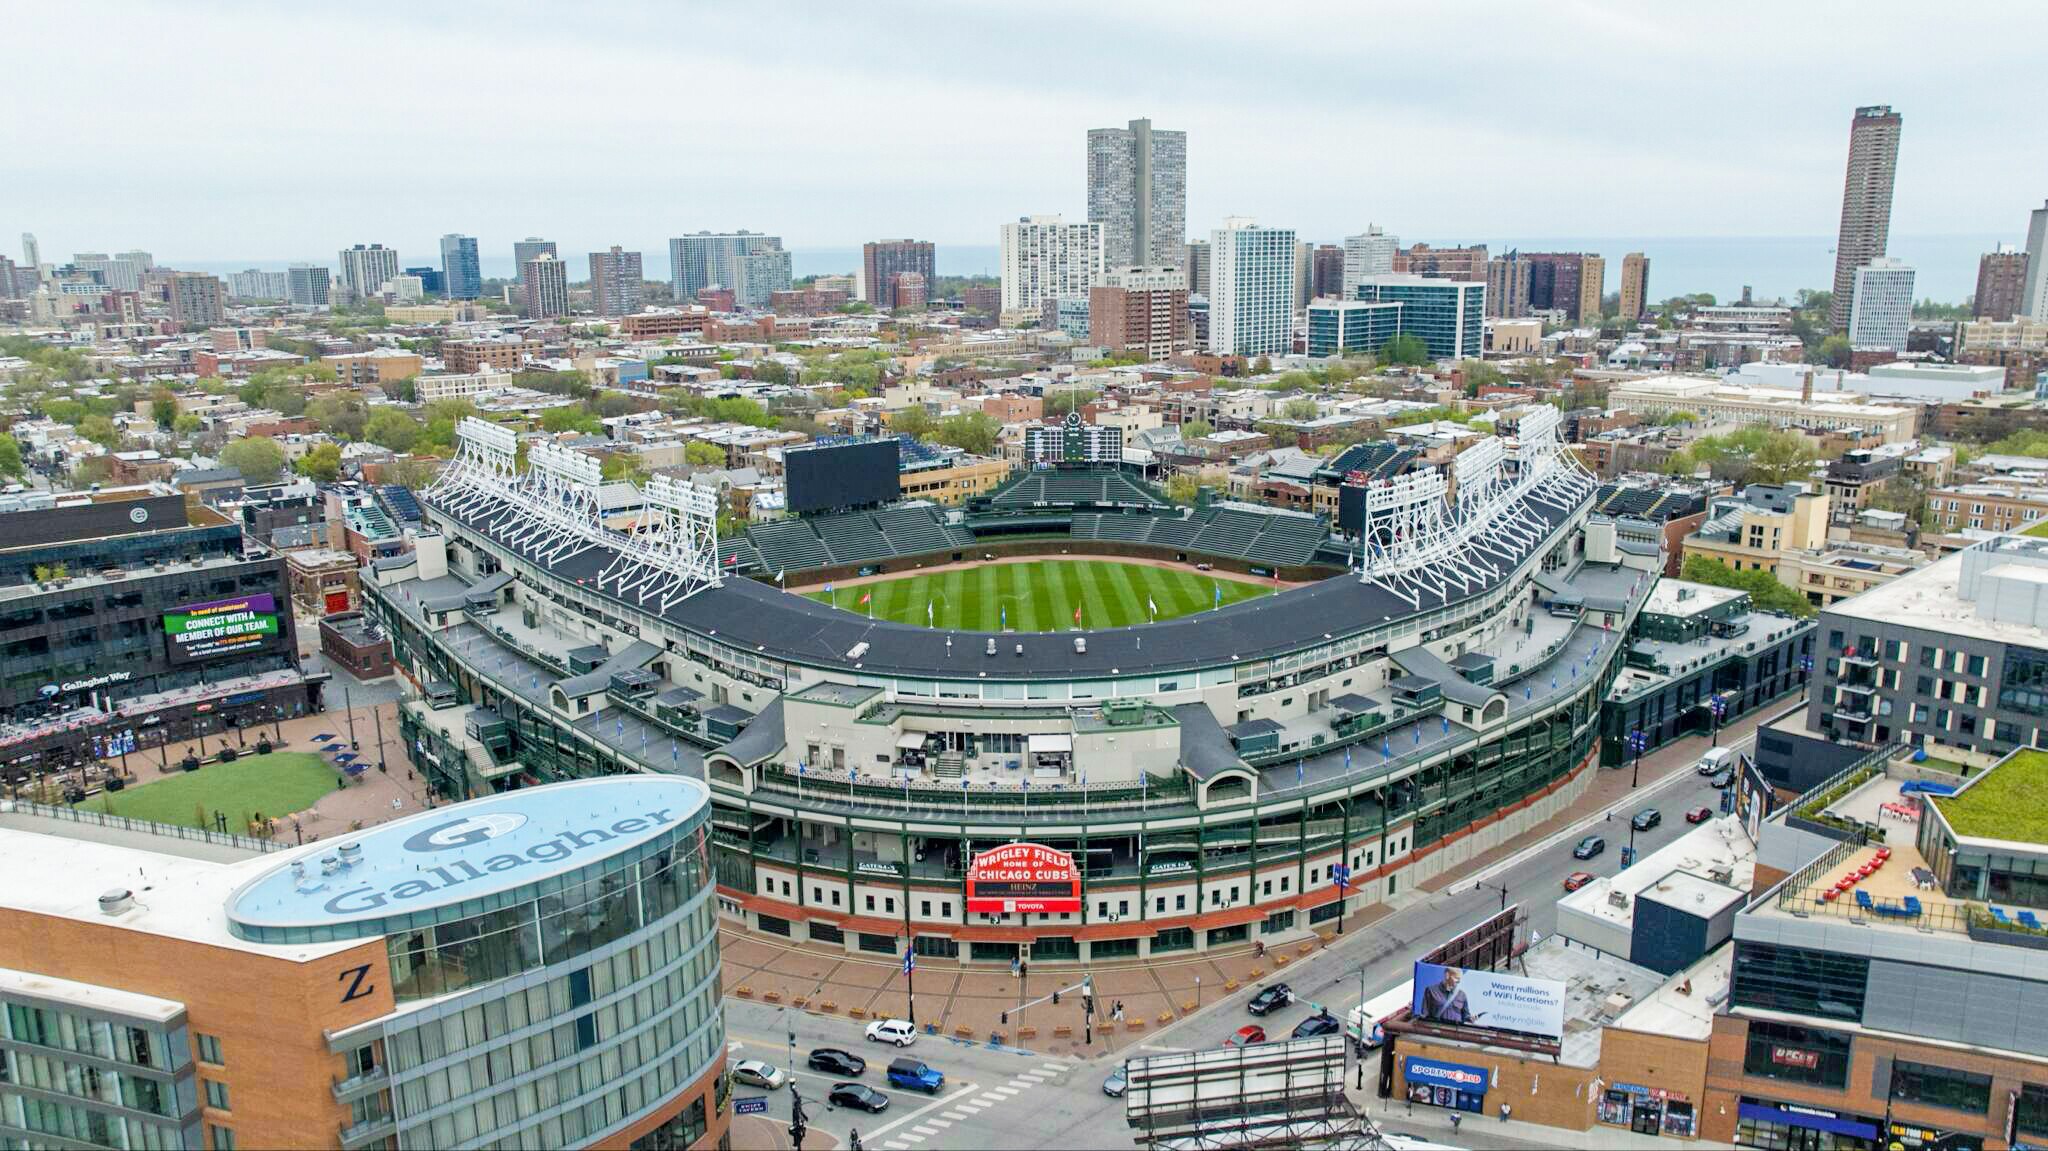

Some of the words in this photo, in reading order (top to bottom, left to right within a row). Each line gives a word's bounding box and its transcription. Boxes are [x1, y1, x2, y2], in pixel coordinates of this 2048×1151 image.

[186, 615, 225, 630] CONNECT
[226, 612, 248, 624] WITH
[249, 610, 256, 620] A
[176, 630, 213, 643] MEMBER
[214, 628, 225, 637] OF
[226, 625, 243, 635] OUR
[245, 620, 269, 632] TEAM.
[62, 676, 109, 691] Gallagher
[109, 671, 131, 681] Way
[323, 806, 675, 915] Gallagher
[978, 848, 1030, 867] WRIGLEY
[1034, 849, 1068, 867] FIELD
[978, 870, 1031, 880] CHICAGO
[1036, 870, 1069, 880] CUBS
[1010, 883, 1037, 891] HEINZ
[338, 963, 375, 1003] Z
[1491, 981, 1514, 991] Want
[1516, 984, 1550, 996] millions
[1482, 989, 1492, 997] of
[1494, 991, 1513, 1001] WiFi
[1514, 993, 1559, 1006] locations?
